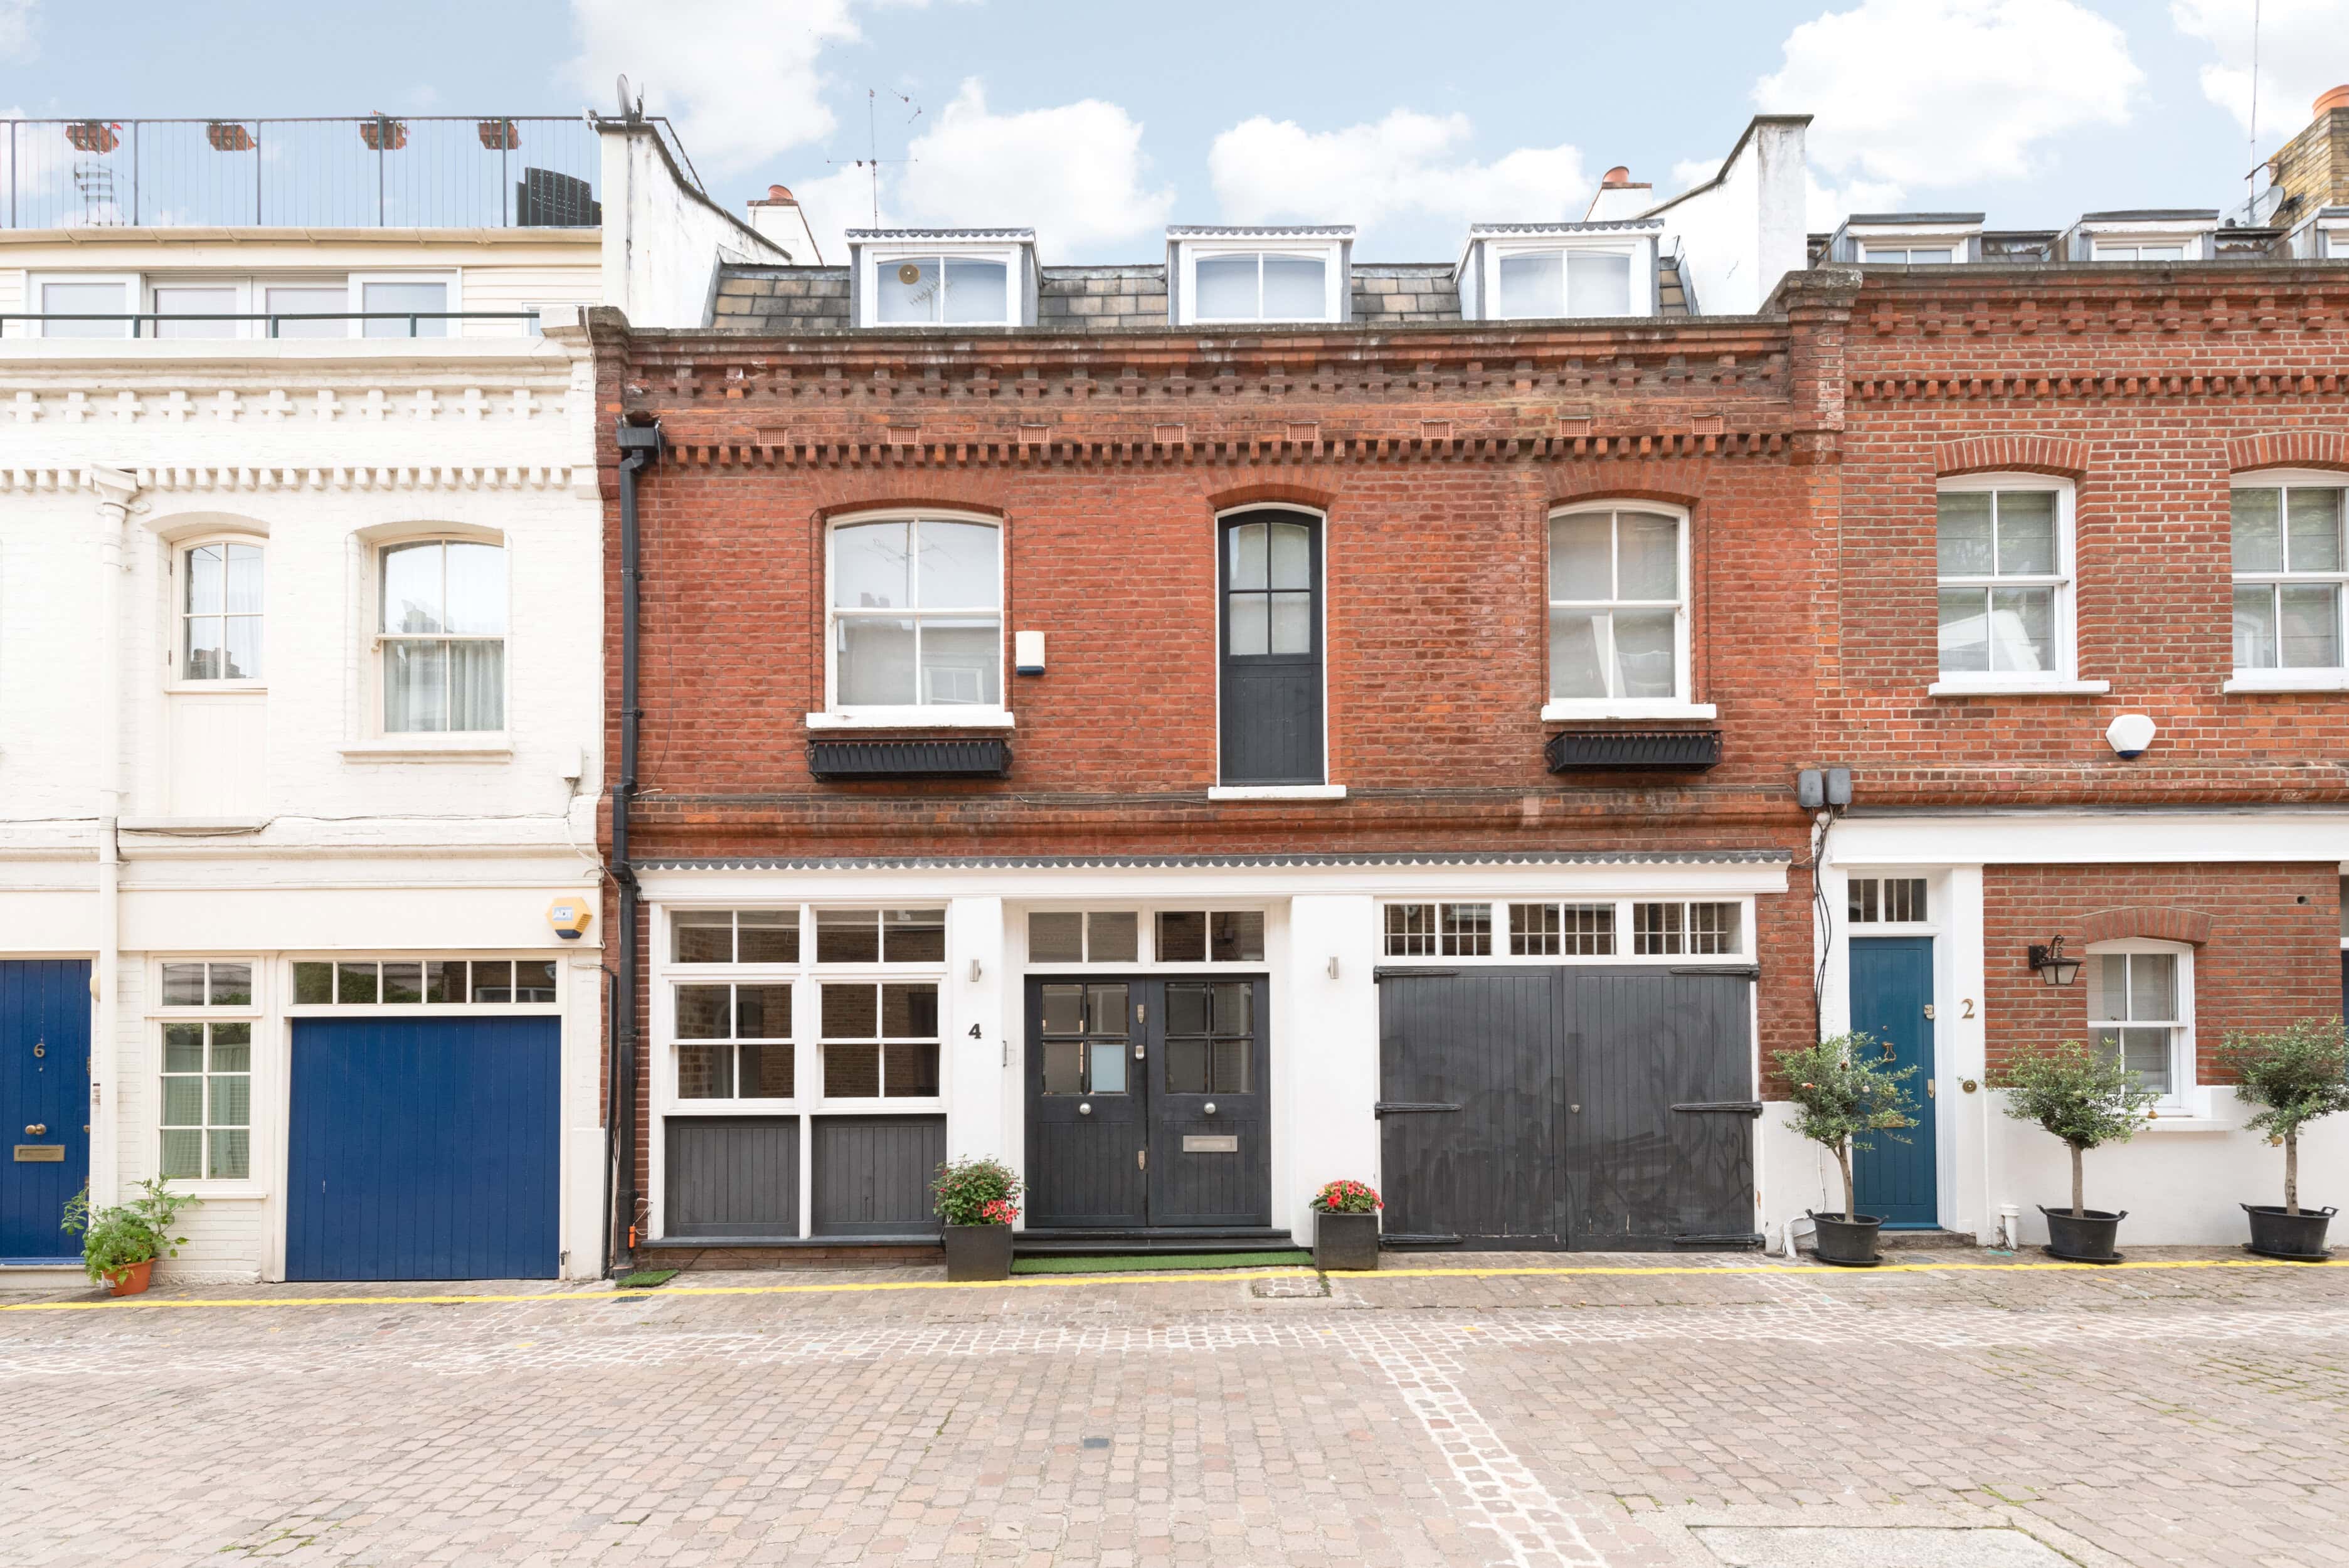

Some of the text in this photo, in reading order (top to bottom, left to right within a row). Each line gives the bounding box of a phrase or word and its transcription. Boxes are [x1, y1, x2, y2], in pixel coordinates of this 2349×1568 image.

[1961, 999, 1975, 1019] 2
[968, 1024, 982, 1039] 4
[34, 1043, 45, 1057] 6
